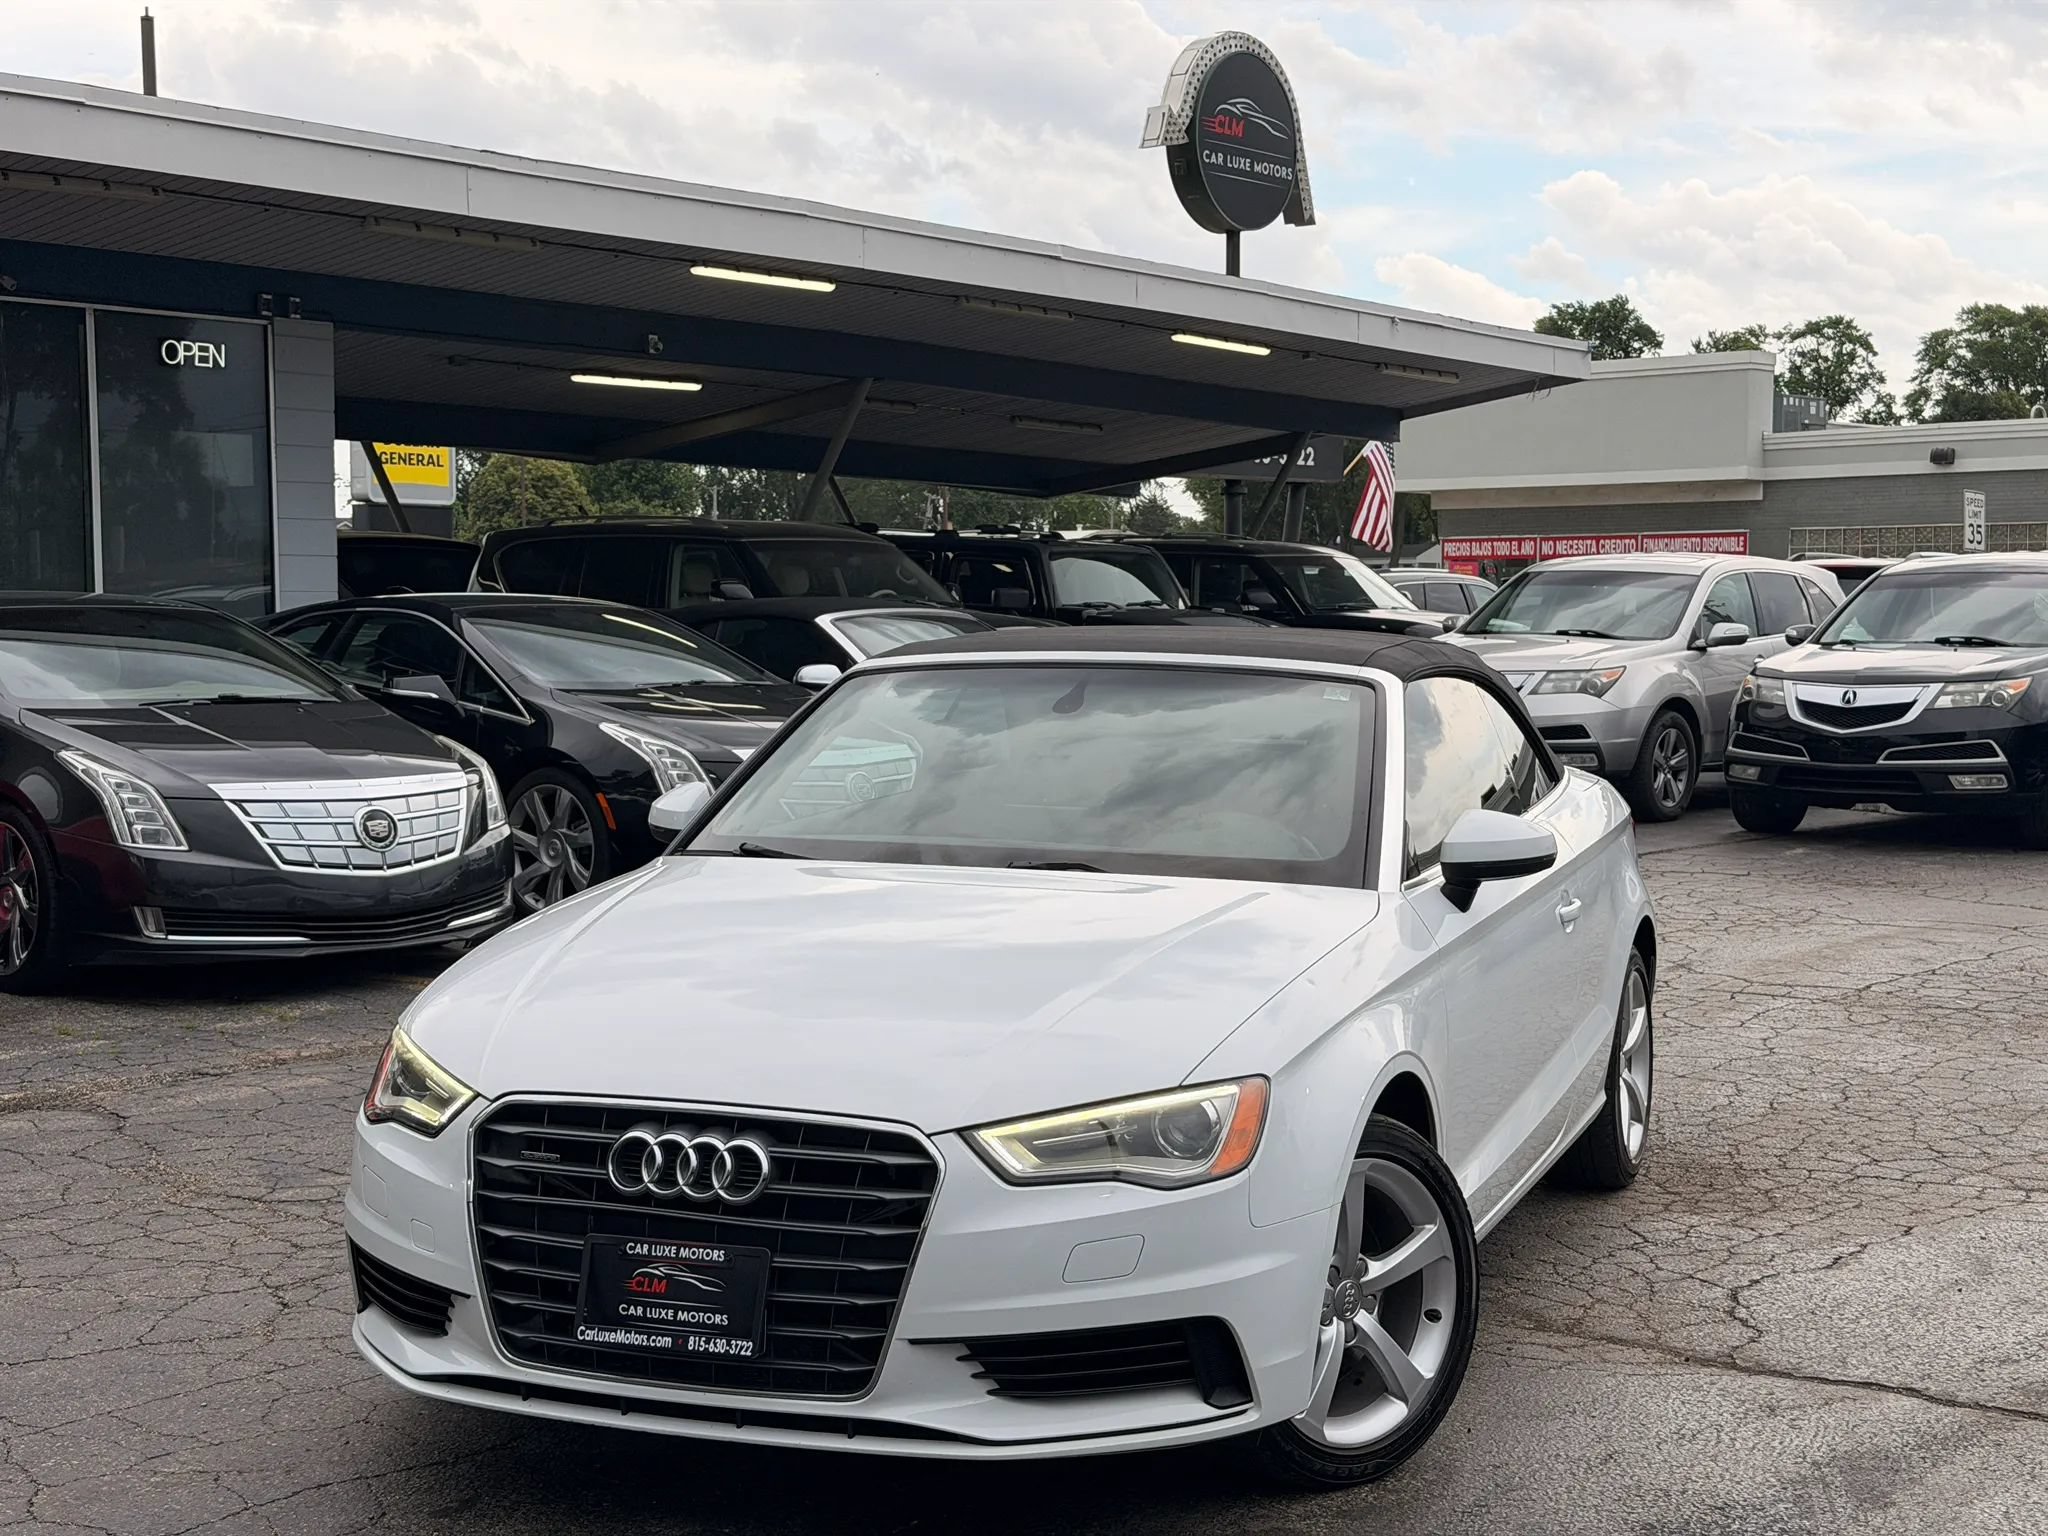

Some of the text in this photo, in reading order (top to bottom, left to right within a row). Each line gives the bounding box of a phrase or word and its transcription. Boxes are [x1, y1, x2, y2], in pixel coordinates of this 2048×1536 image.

[1214, 115, 1245, 137] CLM
[1202, 149, 1293, 181] CAR LUXE MOTORS
[161, 339, 226, 368] OPEN
[379, 451, 445, 468] GENERAL
[1966, 497, 1984, 508] SPEED
[1968, 510, 1982, 520] LIMIT
[1967, 522, 1983, 545] 35
[1443, 538, 1535, 557] PRECIOS BAJOS TODO EL AÑO
[1541, 538, 1637, 555] NO NECESITA CREDITO
[1642, 535, 1745, 553] FINANCIAMIENTO DISPONIBLE
[626, 1242, 725, 1262] CAR LUXE MOTORS
[631, 1276, 668, 1294] CLM
[618, 1304, 729, 1326] CAR LUXE MOTORS
[576, 1325, 753, 1356] CarLuxeMotors.com 815-630-3722
